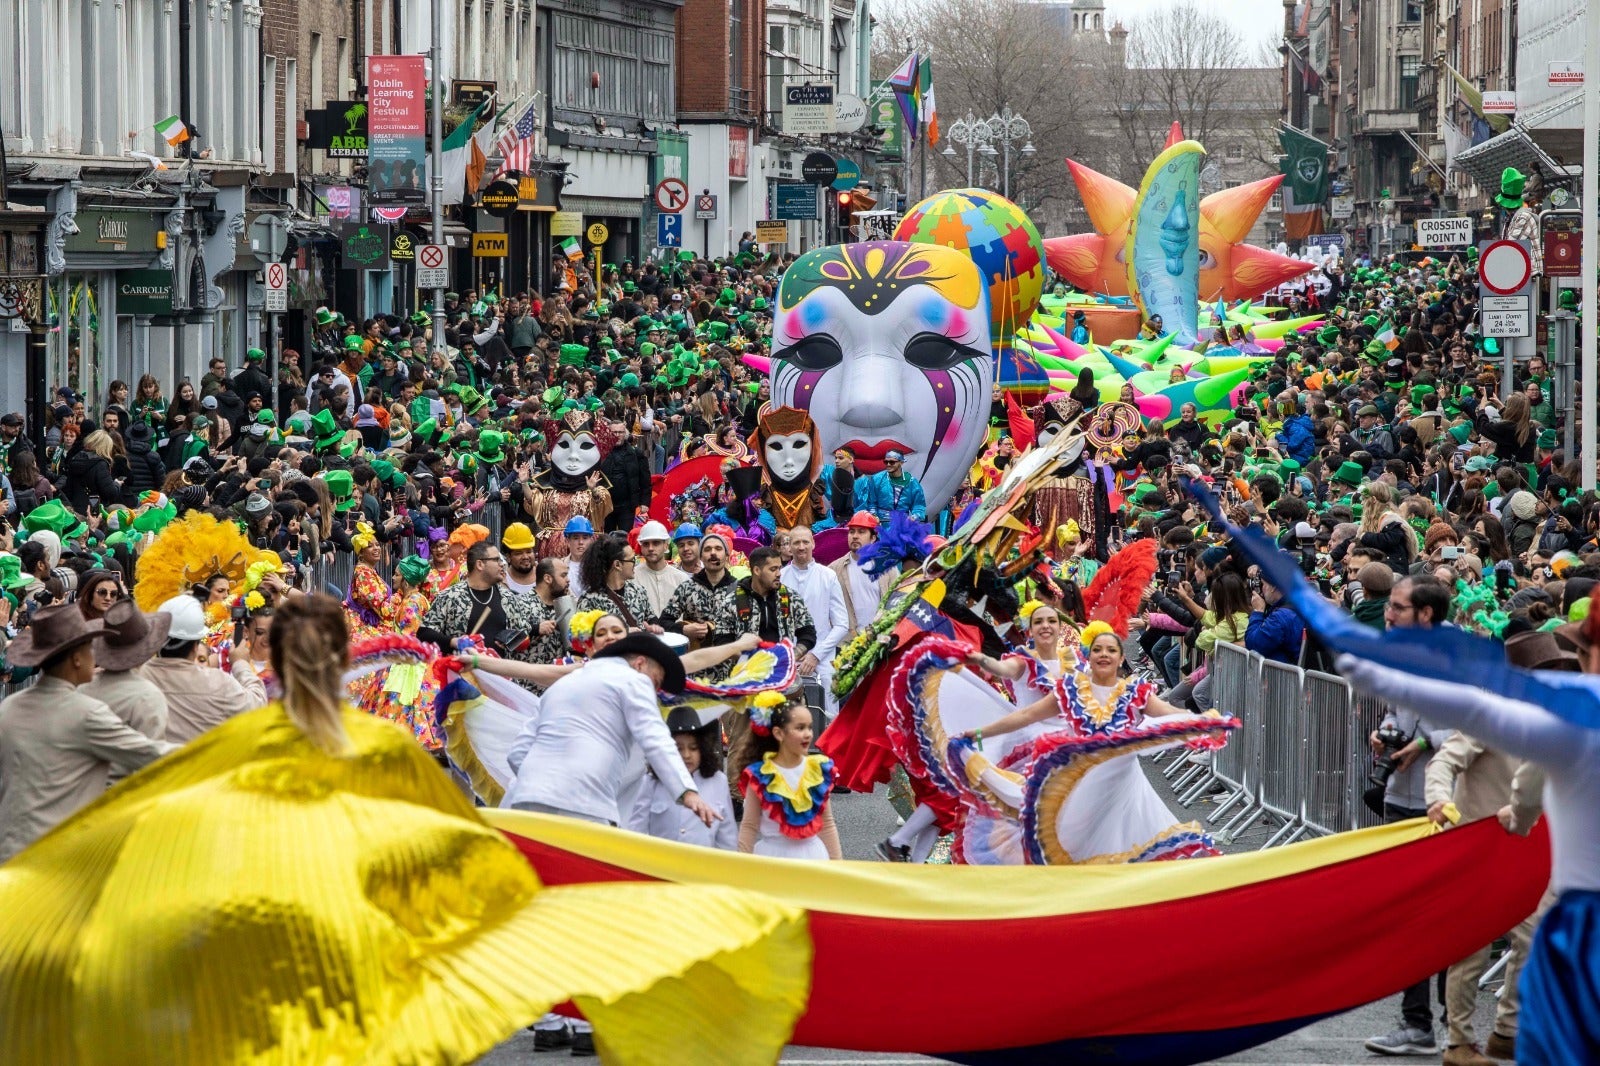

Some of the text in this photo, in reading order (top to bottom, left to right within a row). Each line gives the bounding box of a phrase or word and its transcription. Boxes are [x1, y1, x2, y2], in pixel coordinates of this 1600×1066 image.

[374, 80, 402, 88] Dublin
[374, 89, 414, 98] Learning
[373, 98, 390, 108] City
[374, 108, 408, 116] Festival
[330, 136, 368, 148] ABR
[100, 216, 128, 238] CARROLLS
[665, 216, 675, 230] P
[1422, 220, 1468, 231] CROSSING
[1426, 233, 1466, 243] POINT N
[476, 240, 504, 250] ATM
[122, 284, 169, 294] CARROLLS
